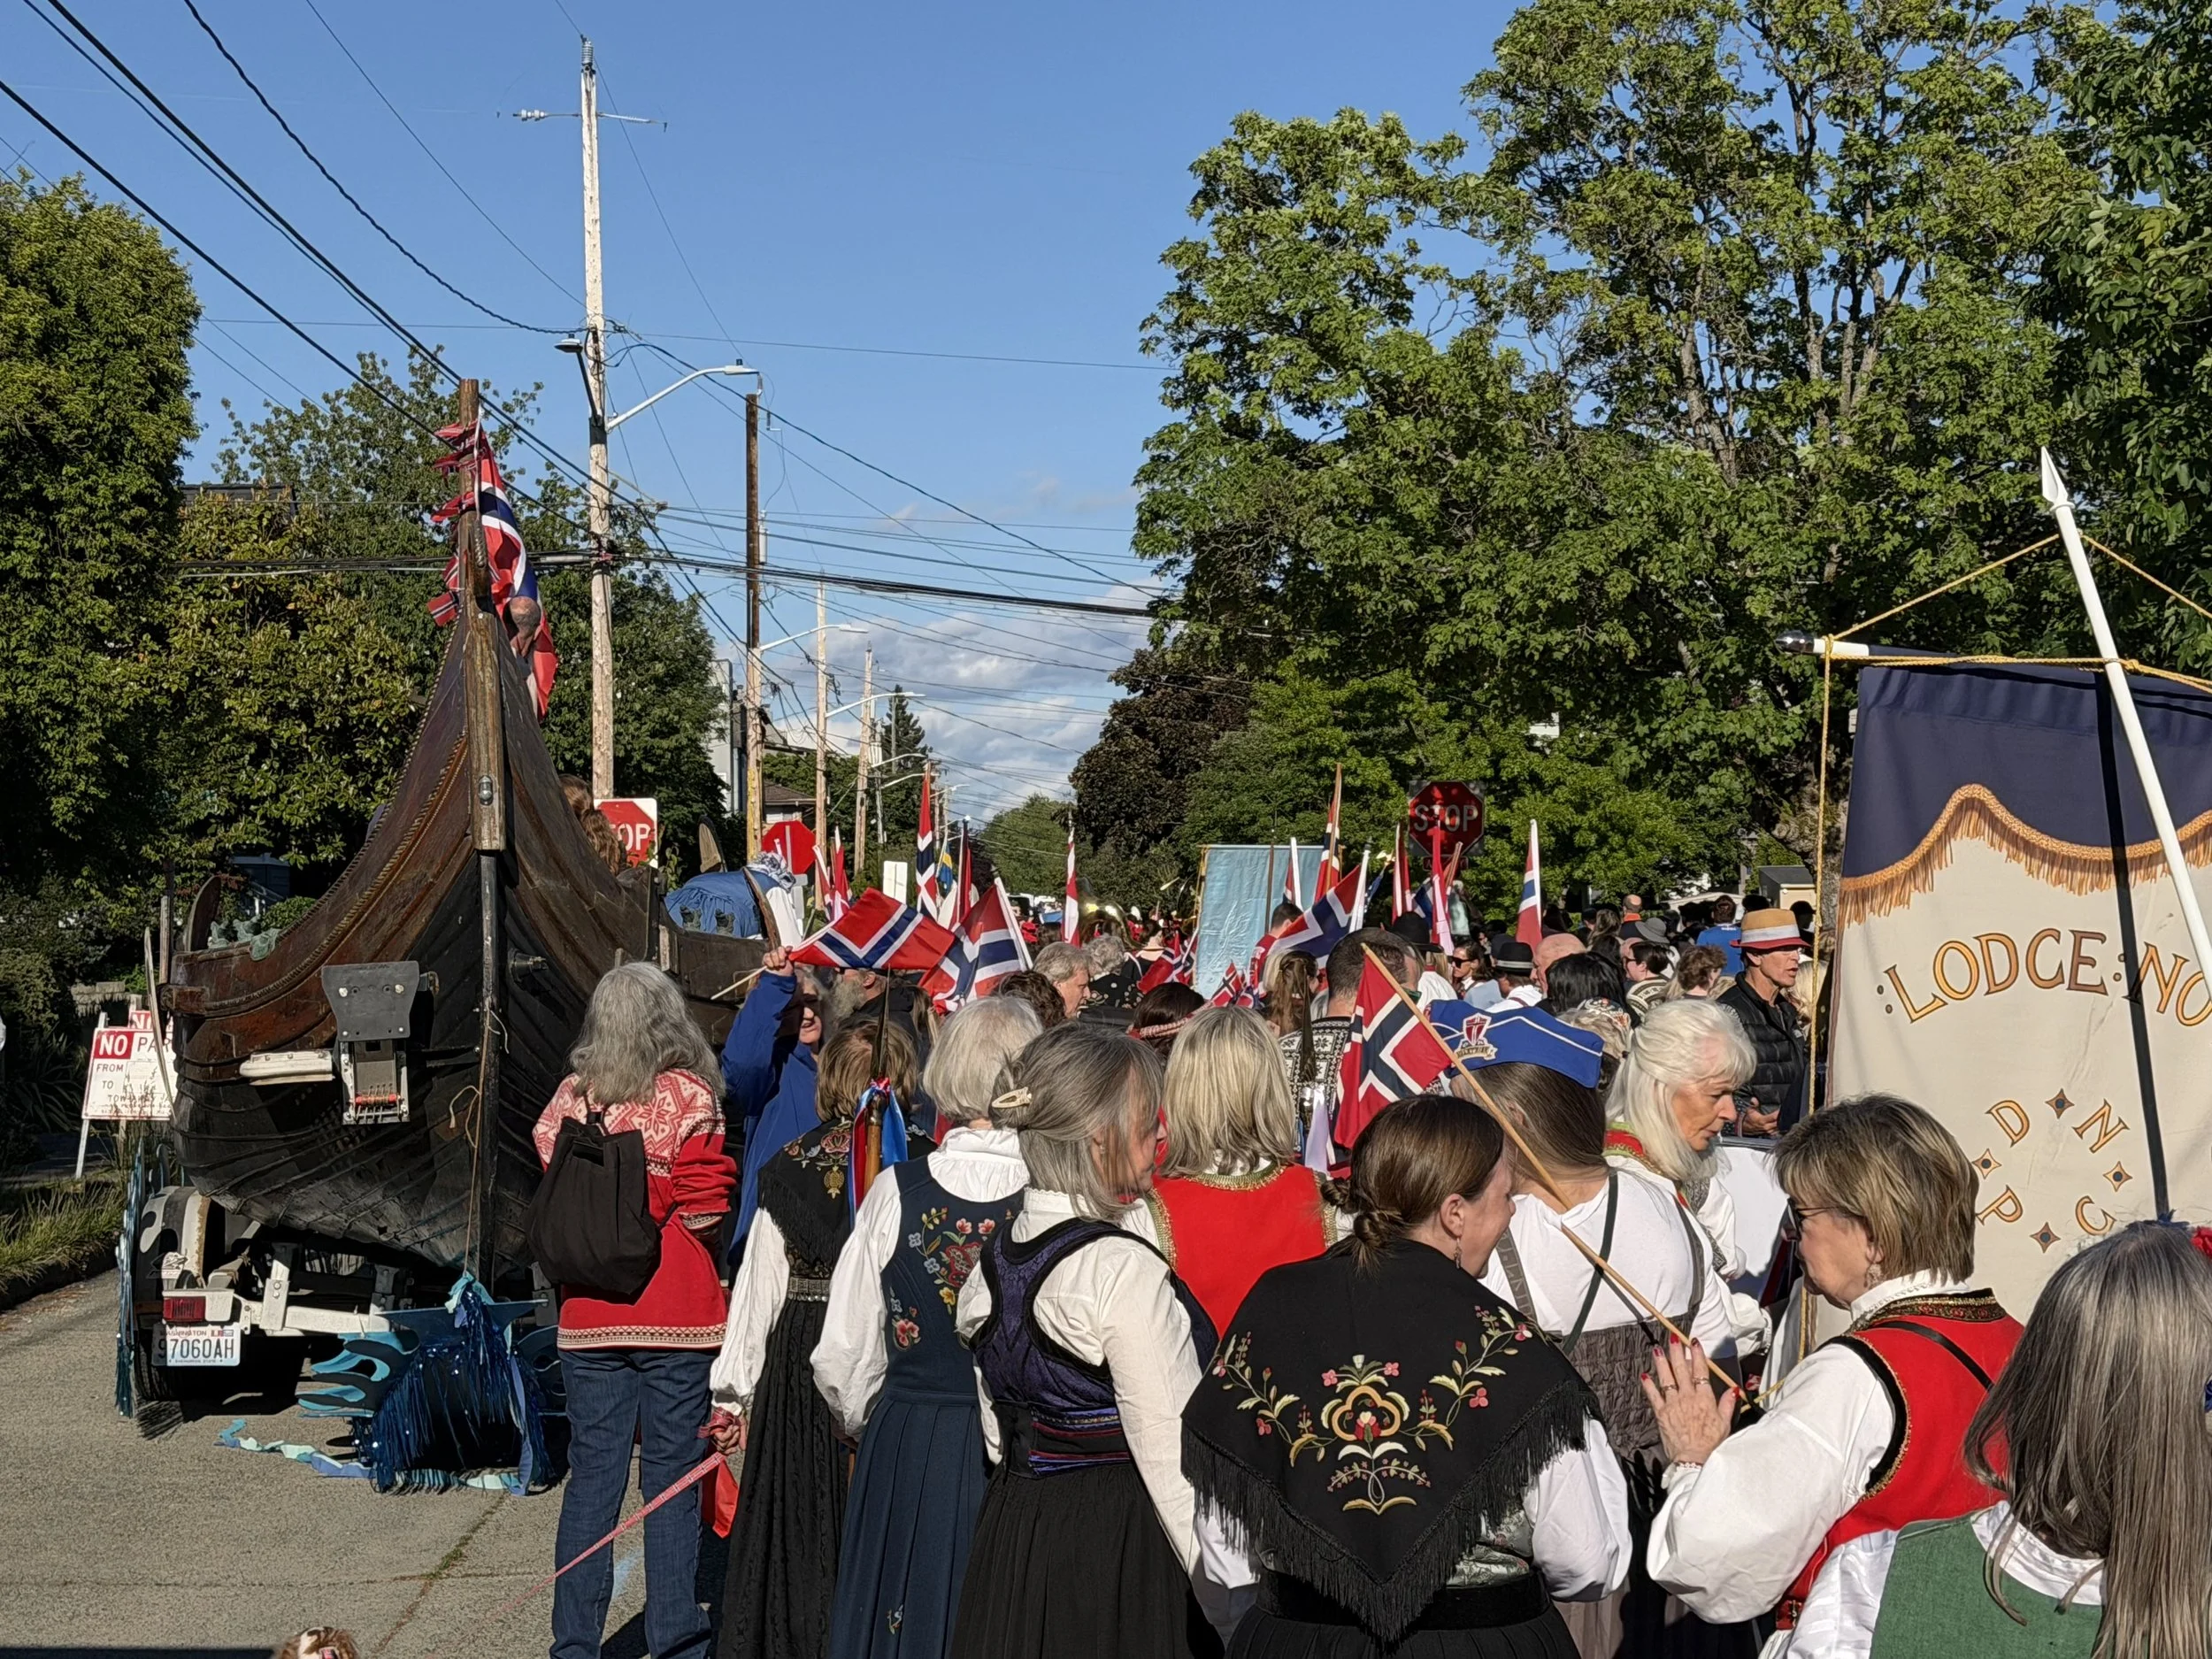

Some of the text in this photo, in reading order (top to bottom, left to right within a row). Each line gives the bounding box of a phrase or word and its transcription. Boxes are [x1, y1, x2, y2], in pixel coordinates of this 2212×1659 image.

[1414, 803, 1479, 833] STOP
[610, 823, 650, 851] OP
[98, 1034, 128, 1056] NO
[96, 1064, 124, 1072] FROM
[101, 1080, 114, 1089] TO
[1985, 1098, 2131, 1154] D N
[1975, 1184, 2024, 1226] P
[158, 1338, 234, 1359] 97060AH
